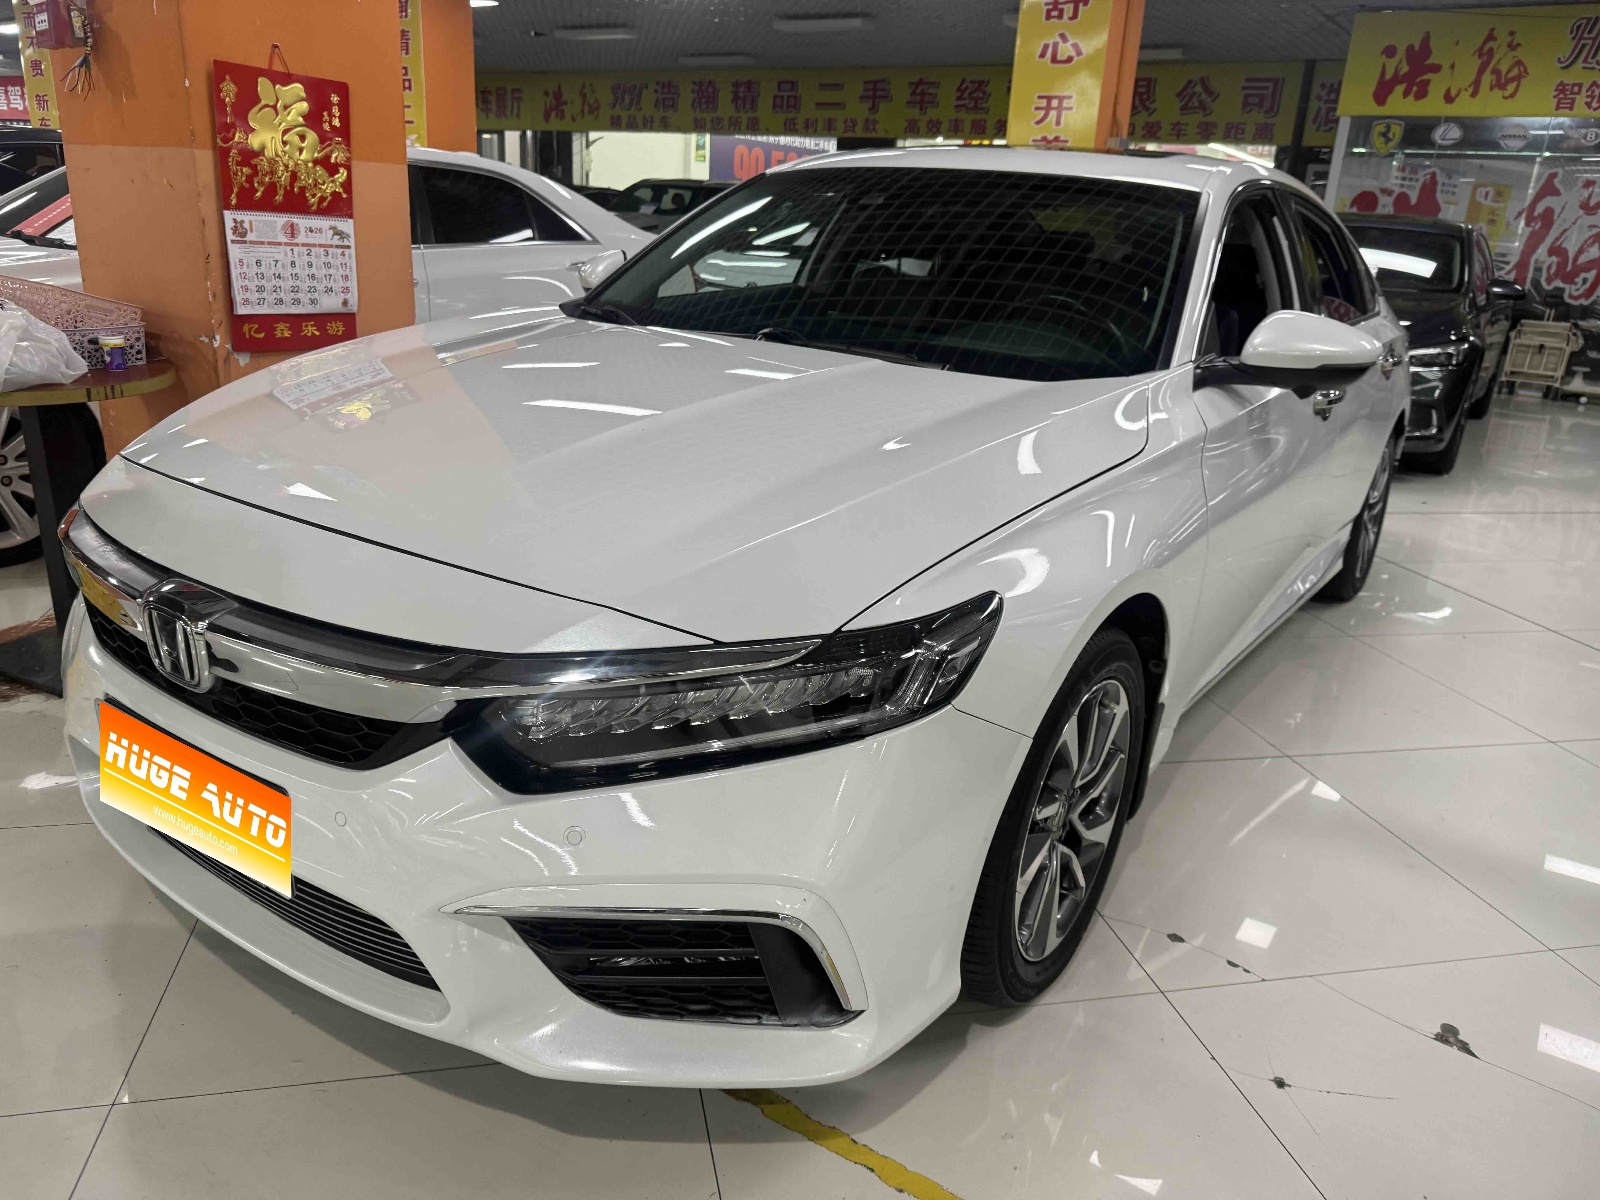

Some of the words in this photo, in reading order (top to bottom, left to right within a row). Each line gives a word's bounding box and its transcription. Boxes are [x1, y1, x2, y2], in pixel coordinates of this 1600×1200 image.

[654, 77, 1012, 114] 浩瀚精品二手车经
[238, 259, 244, 267] 5
[255, 260, 262, 268] 6
[273, 260, 279, 268] 7
[307, 261, 313, 269] 9
[238, 272, 247, 280] 12
[290, 273, 299, 281] 15
[324, 274, 332, 282] 17
[340, 274, 349, 282] 18
[240, 285, 249, 293] 19
[255, 285, 265, 293] 20
[274, 298, 284, 306] 28
[291, 298, 301, 306] 29
[308, 298, 318, 306] 30
[242, 321, 346, 338] 忆鑫乐游
